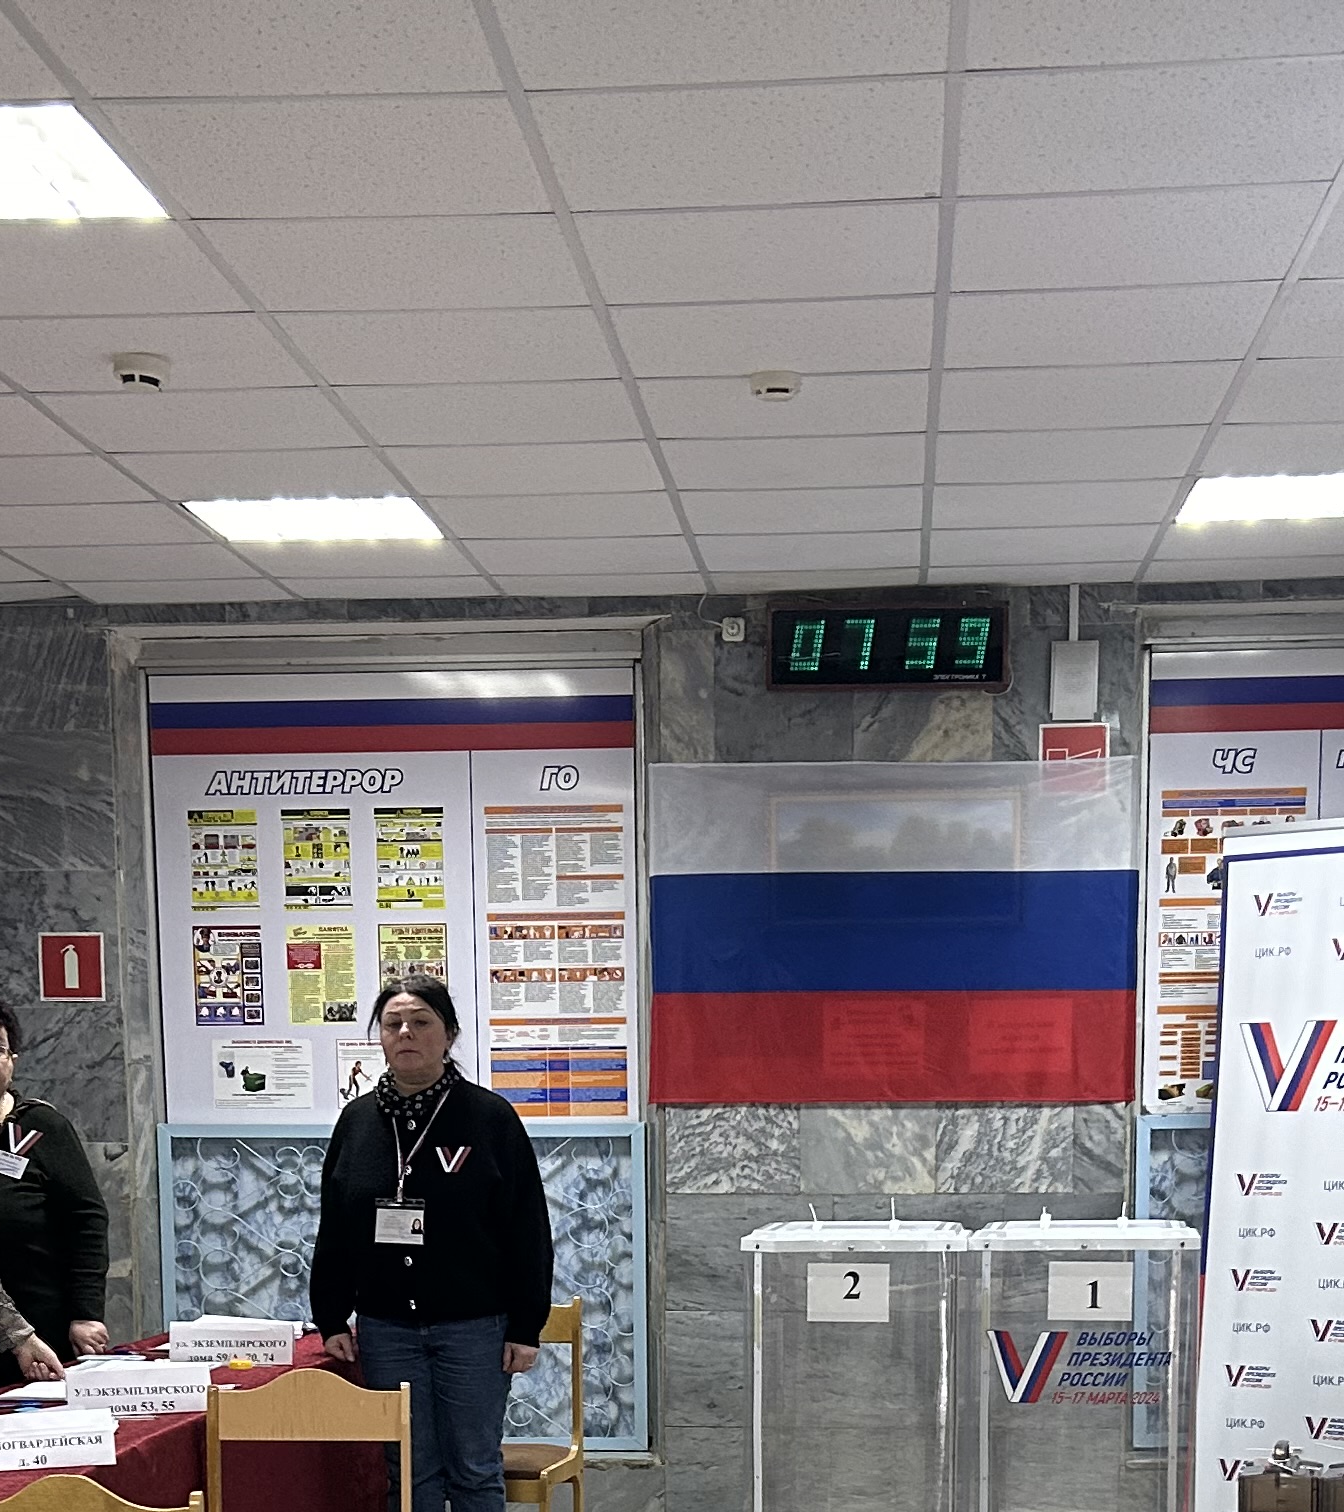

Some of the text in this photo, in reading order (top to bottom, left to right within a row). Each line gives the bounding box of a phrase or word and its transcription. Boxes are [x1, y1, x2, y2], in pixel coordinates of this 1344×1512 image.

[1213, 748, 1257, 774] ЧС
[205, 768, 404, 796] АНТИТЕРРОР
[540, 765, 579, 791] ГО
[1254, 946, 1291, 959] ЦИК.РФ
[1239, 1227, 1276, 1239] ЦИК.РФ
[843, 1272, 861, 1300] 2
[1086, 1280, 1101, 1309] 1
[1233, 1322, 1270, 1333] ЦИК.РФ
[192, 1340, 286, 1348] ЭКЗЕМПЛЯРСКОГО
[1076, 1332, 1154, 1346] ВЫБОРЫ
[263, 1353, 274, 1362] 74
[1067, 1352, 1172, 1369] ПРЕЗИДЕНТА
[1057, 1372, 1129, 1387] РОССИИ
[1086, 1391, 1128, 1404] МАРТА
[1130, 1391, 1161, 1404] 2024
[161, 1401, 175, 1411] 55
[1226, 1417, 1265, 1429] ЦИК.РФ
[18, 1455, 47, 1467] д. 40
